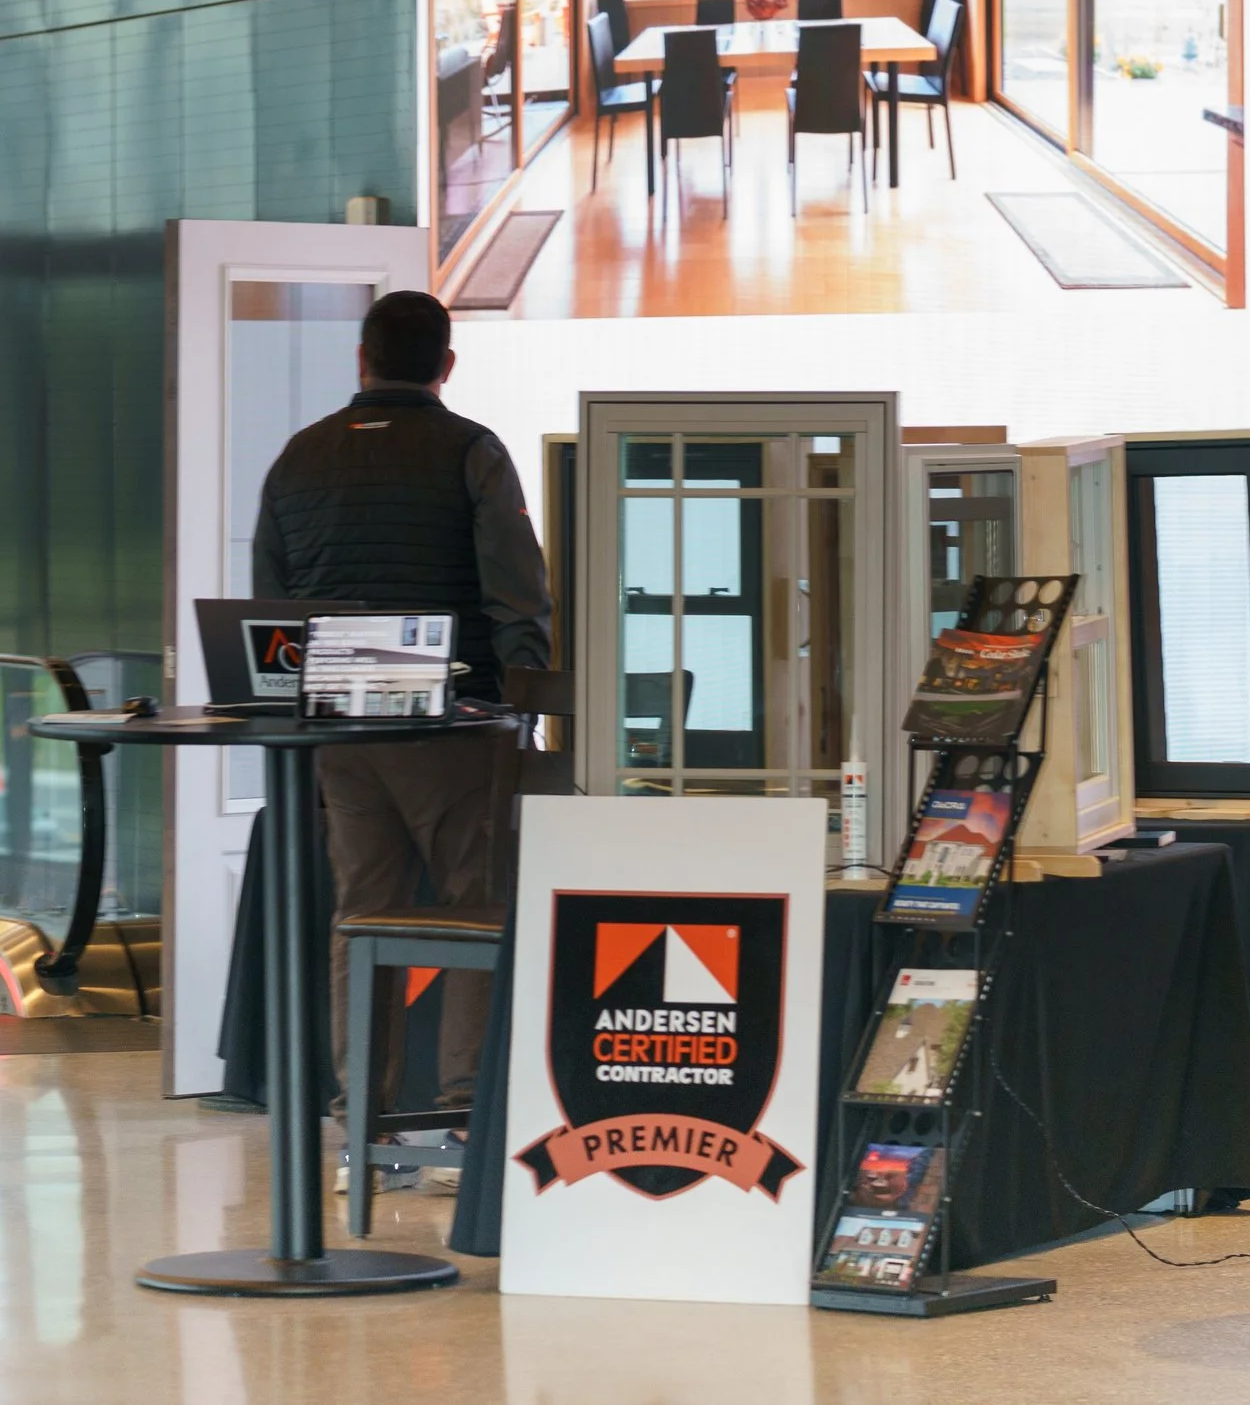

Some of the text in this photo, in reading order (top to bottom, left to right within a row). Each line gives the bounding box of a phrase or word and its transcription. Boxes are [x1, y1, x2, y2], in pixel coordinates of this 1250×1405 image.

[595, 1009, 736, 1033] ANDERSEN
[593, 1034, 737, 1065] CERTIFIED
[596, 1065, 735, 1085] CONTRACTOR
[581, 1126, 738, 1168] PREMIER
